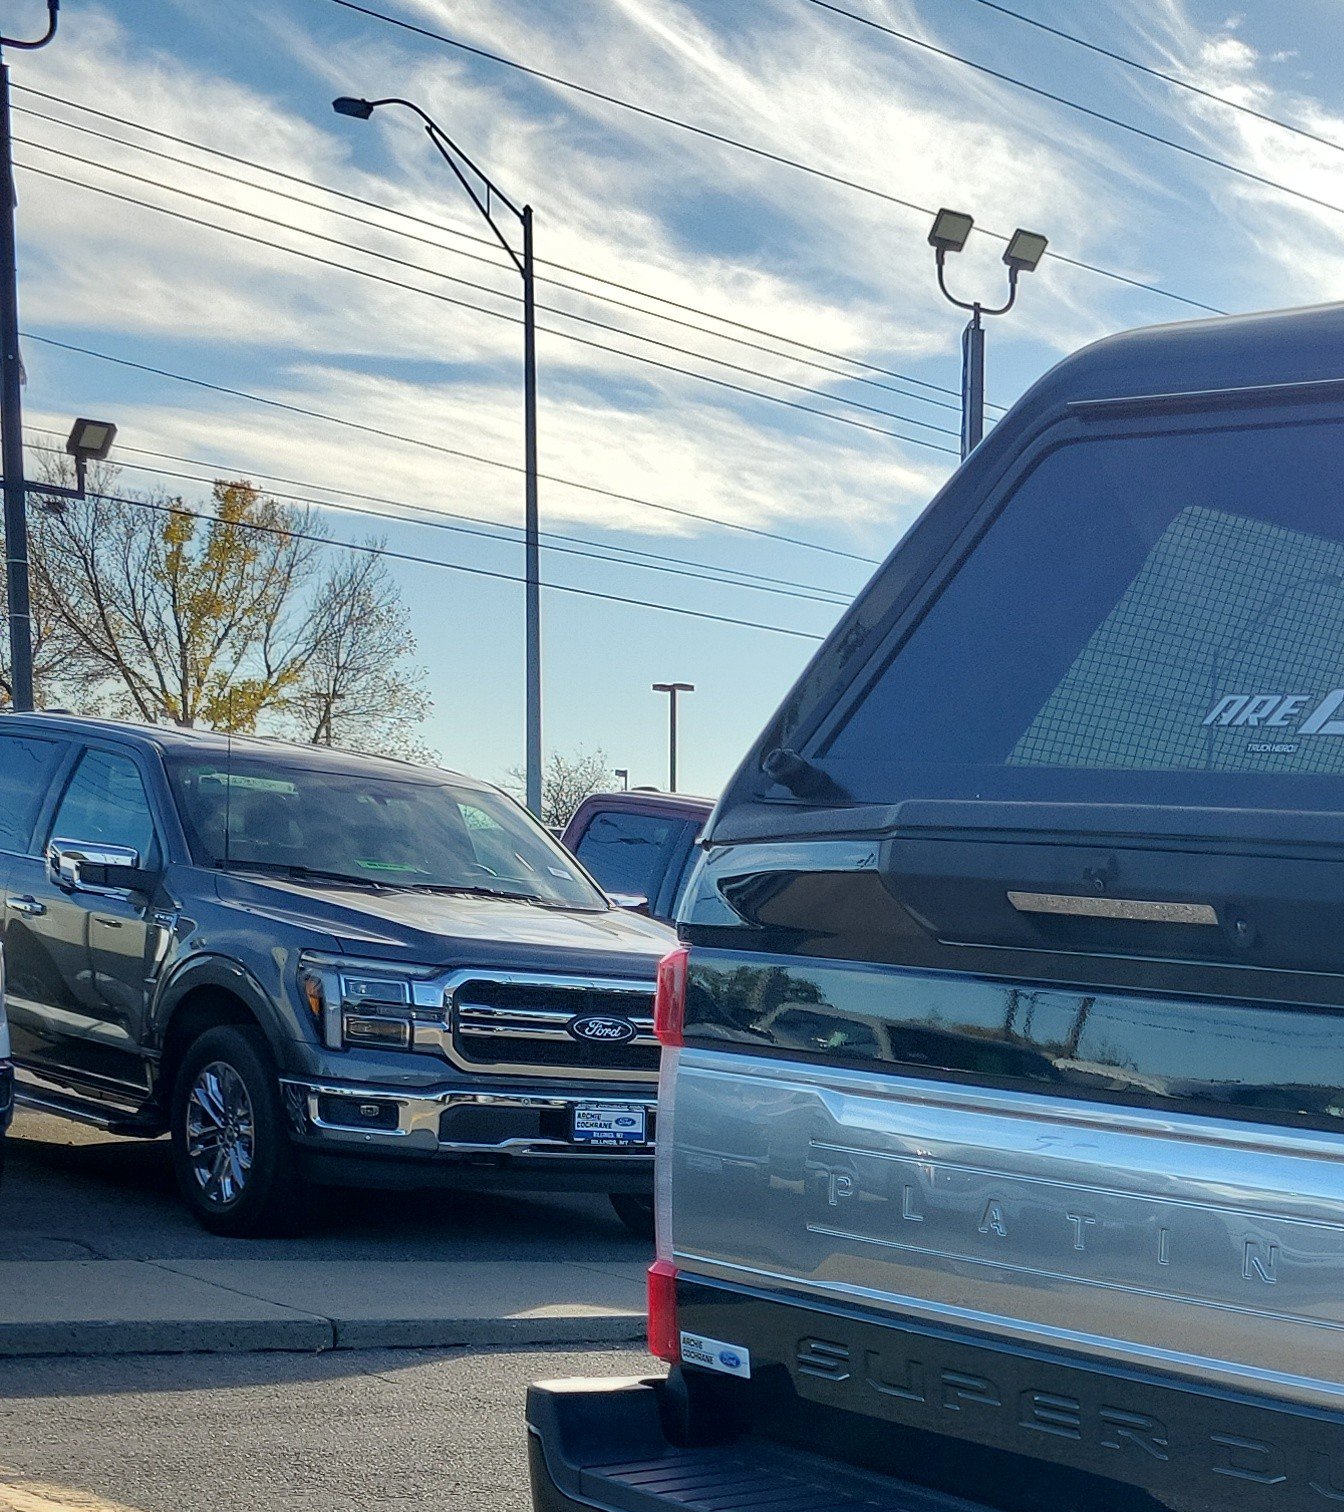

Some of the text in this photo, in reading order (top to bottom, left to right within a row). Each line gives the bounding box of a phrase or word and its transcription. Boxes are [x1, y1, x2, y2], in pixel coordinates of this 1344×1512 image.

[1202, 694, 1313, 726] ARE
[585, 1020, 622, 1037] Ford
[797, 1336, 1169, 1461] SUPER
